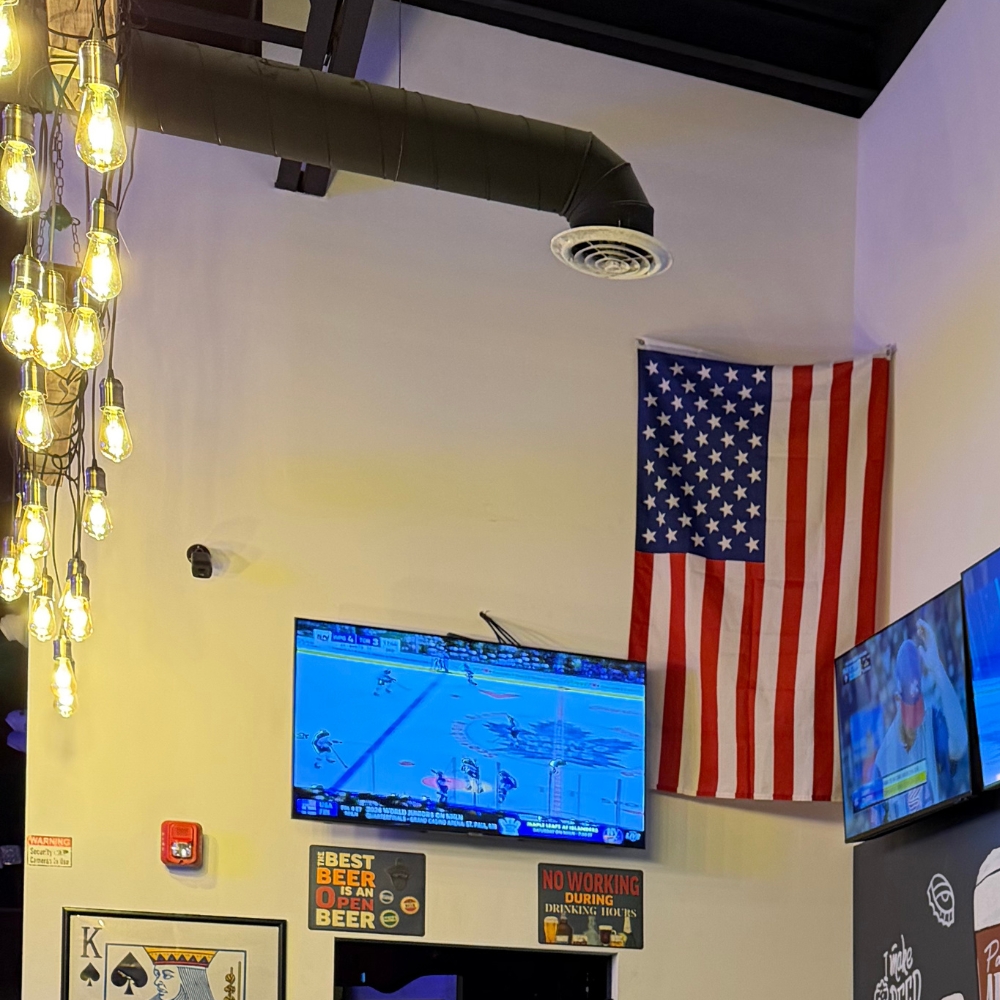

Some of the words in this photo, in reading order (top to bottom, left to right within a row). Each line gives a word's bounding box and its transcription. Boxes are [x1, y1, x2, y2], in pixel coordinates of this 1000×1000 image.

[31, 836, 71, 847] WARNING
[317, 851, 325, 867] THE
[325, 851, 375, 870] BEST
[316, 867, 376, 888] BEER
[542, 869, 564, 891] NO
[566, 871, 639, 896] WORKING
[315, 886, 373, 911] OPEN
[340, 886, 352, 896] IS
[356, 888, 373, 898] AN
[564, 892, 613, 906] DURING
[315, 908, 375, 929] BEER
[545, 903, 597, 916] DRINKING
[601, 907, 637, 918] HOURS
[80, 927, 102, 959] K
[889, 934, 913, 982] make
